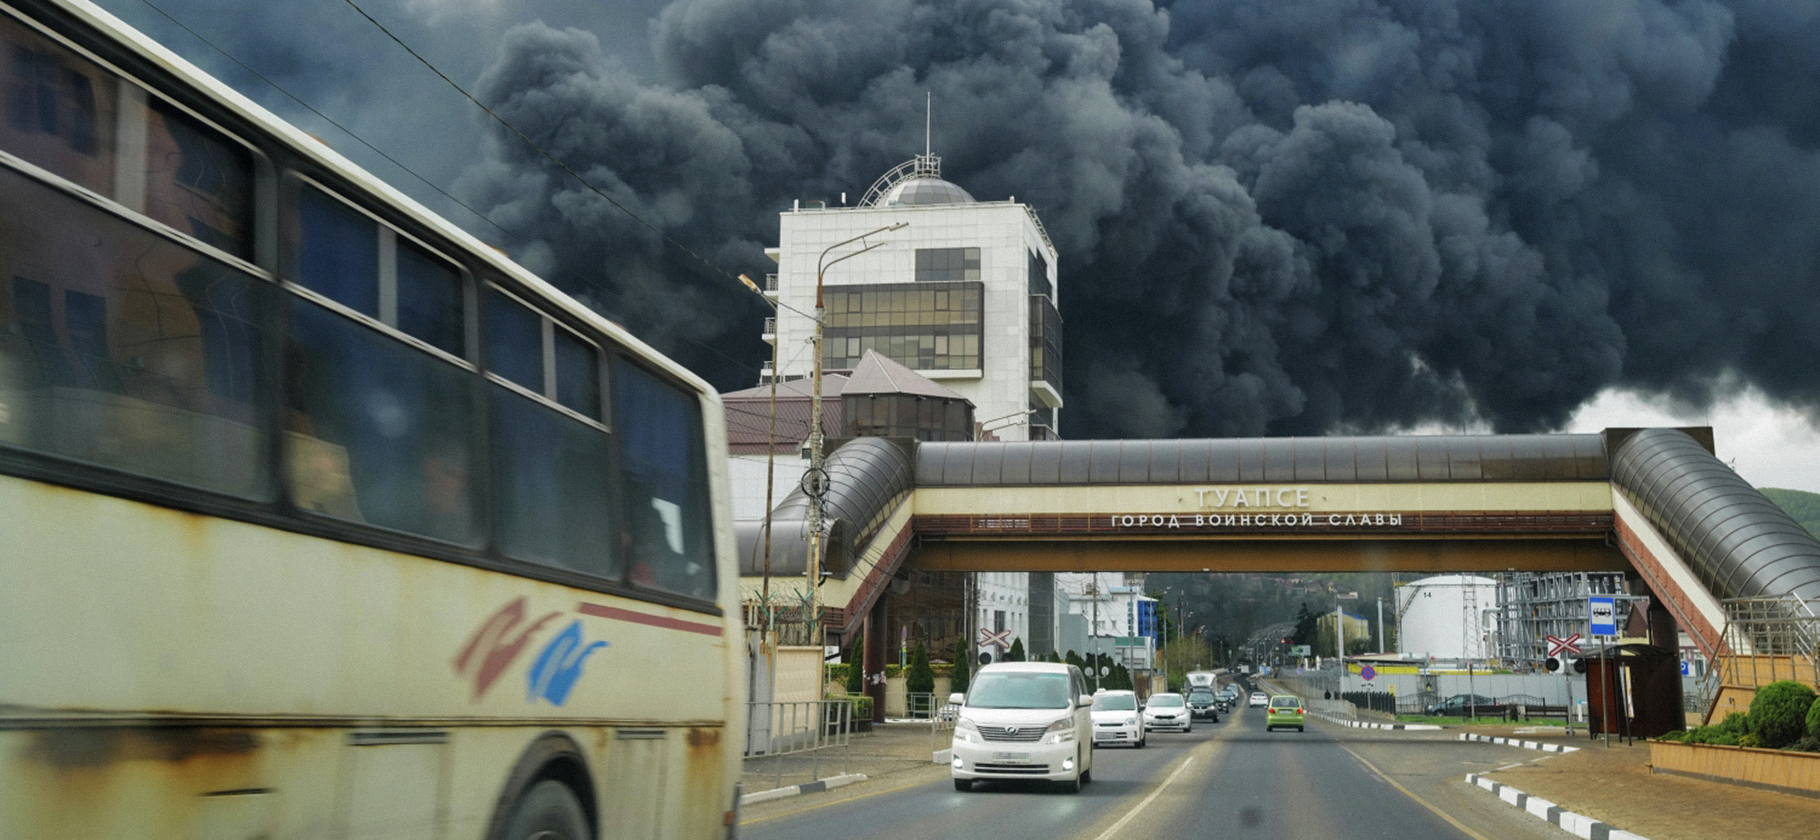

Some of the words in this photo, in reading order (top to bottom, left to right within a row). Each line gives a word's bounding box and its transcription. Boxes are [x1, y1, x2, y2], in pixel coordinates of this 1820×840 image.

[1194, 488, 1310, 508] ТУАПСЕ
[1111, 515, 1180, 528] ГОРОД
[1195, 512, 1313, 527] ВОИНСКОЙ
[1328, 513, 1402, 526] СЛАВЫ
[1423, 591, 1432, 599] 14
